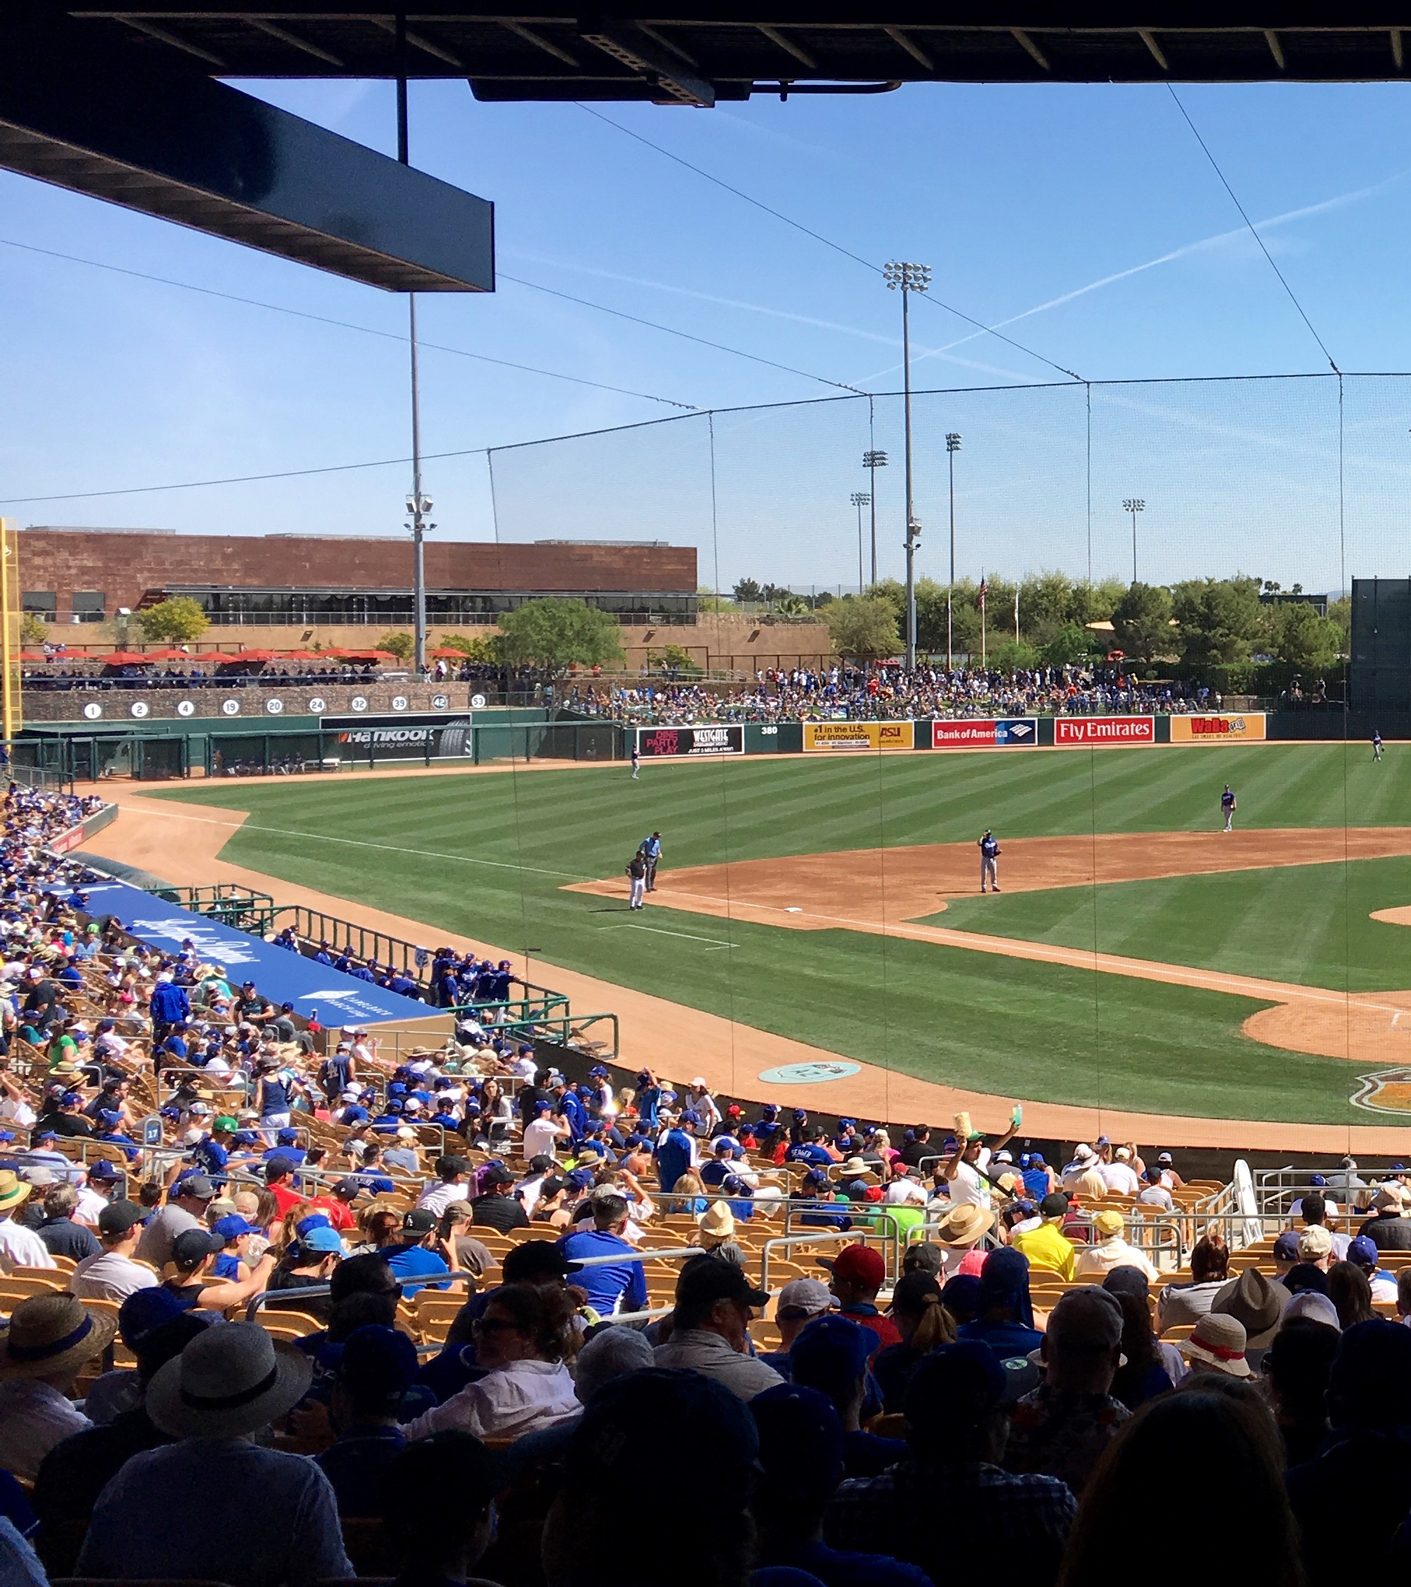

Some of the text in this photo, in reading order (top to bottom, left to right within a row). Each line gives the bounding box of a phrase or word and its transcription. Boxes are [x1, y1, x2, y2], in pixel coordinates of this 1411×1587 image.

[760, 726, 778, 735] 380
[824, 725, 833, 733] in
[833, 725, 848, 733] the
[1191, 717, 1230, 734] WaBa
[655, 730, 679, 740] DINE
[814, 732, 871, 741] for innovation
[879, 727, 901, 738] ASU
[937, 728, 1009, 739] Bank of America
[1060, 722, 1150, 741] Fly Emirates
[646, 738, 679, 748] PARTY
[654, 746, 679, 755] PLAY
[147, 1128, 158, 1139] 17
